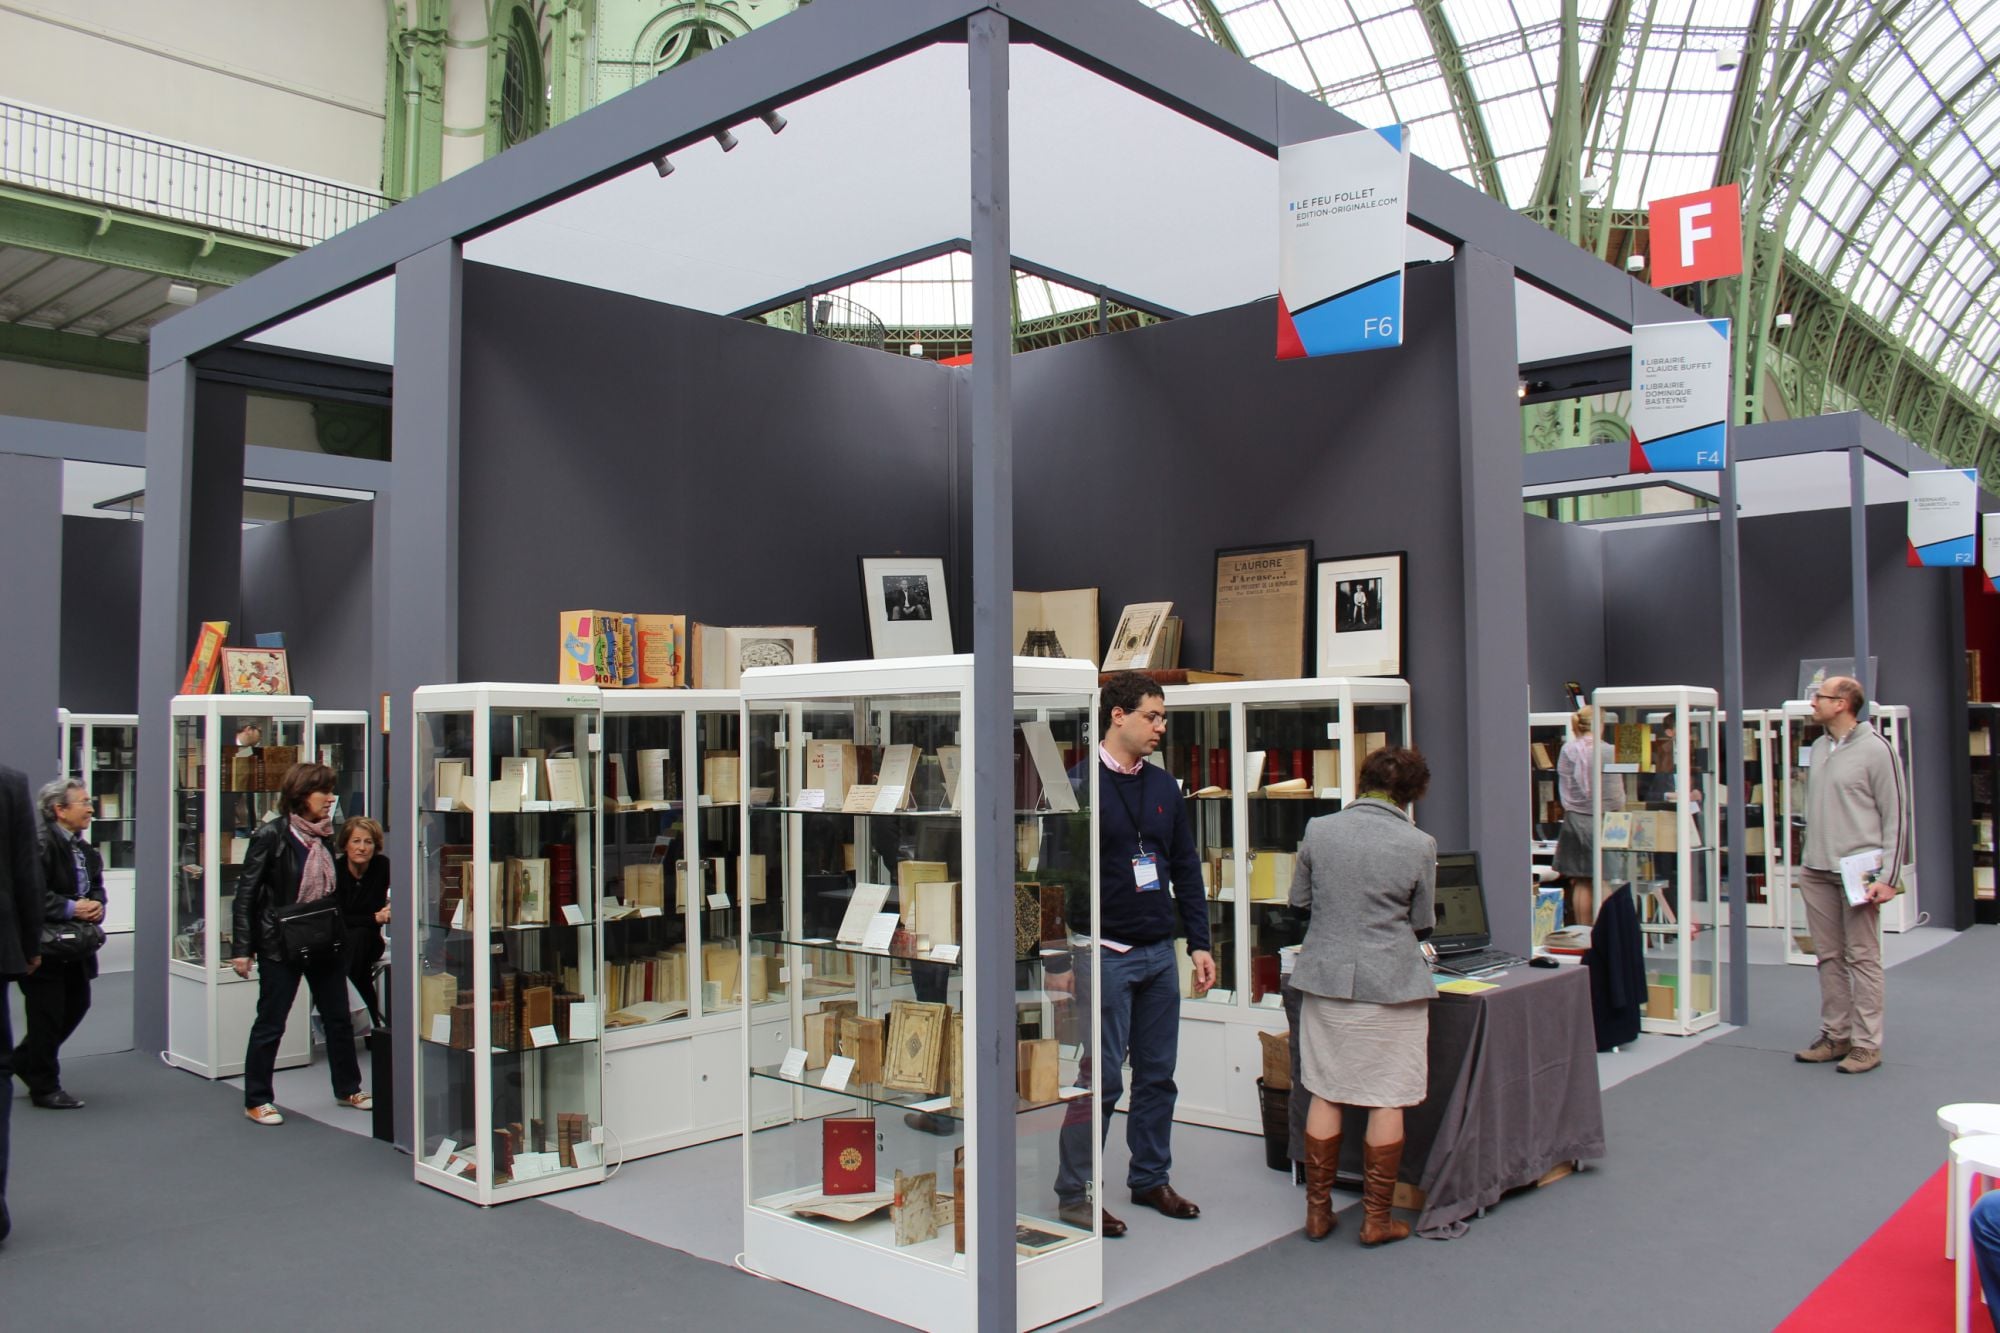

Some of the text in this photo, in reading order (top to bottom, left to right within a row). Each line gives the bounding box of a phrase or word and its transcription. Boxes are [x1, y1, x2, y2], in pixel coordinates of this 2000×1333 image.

[1296, 187, 1375, 210] LE FEU FOLLET
[1296, 197, 1398, 221] EDITION-ORIGINALE.COM
[1678, 201, 1712, 268] F
[1364, 315, 1393, 339] F6
[1646, 356, 1686, 366] LIBRAIRIE
[1646, 362, 1712, 373] CLAUDE BUFFET
[1646, 381, 1685, 390] LIBRAIRIE
[1645, 388, 1692, 398] DOMINIQUE
[1645, 396, 1687, 405] BASTEYNS
[1696, 450, 1720, 465] F4
[1956, 554, 1971, 563] F2
[1234, 558, 1283, 572] L'AURORE
